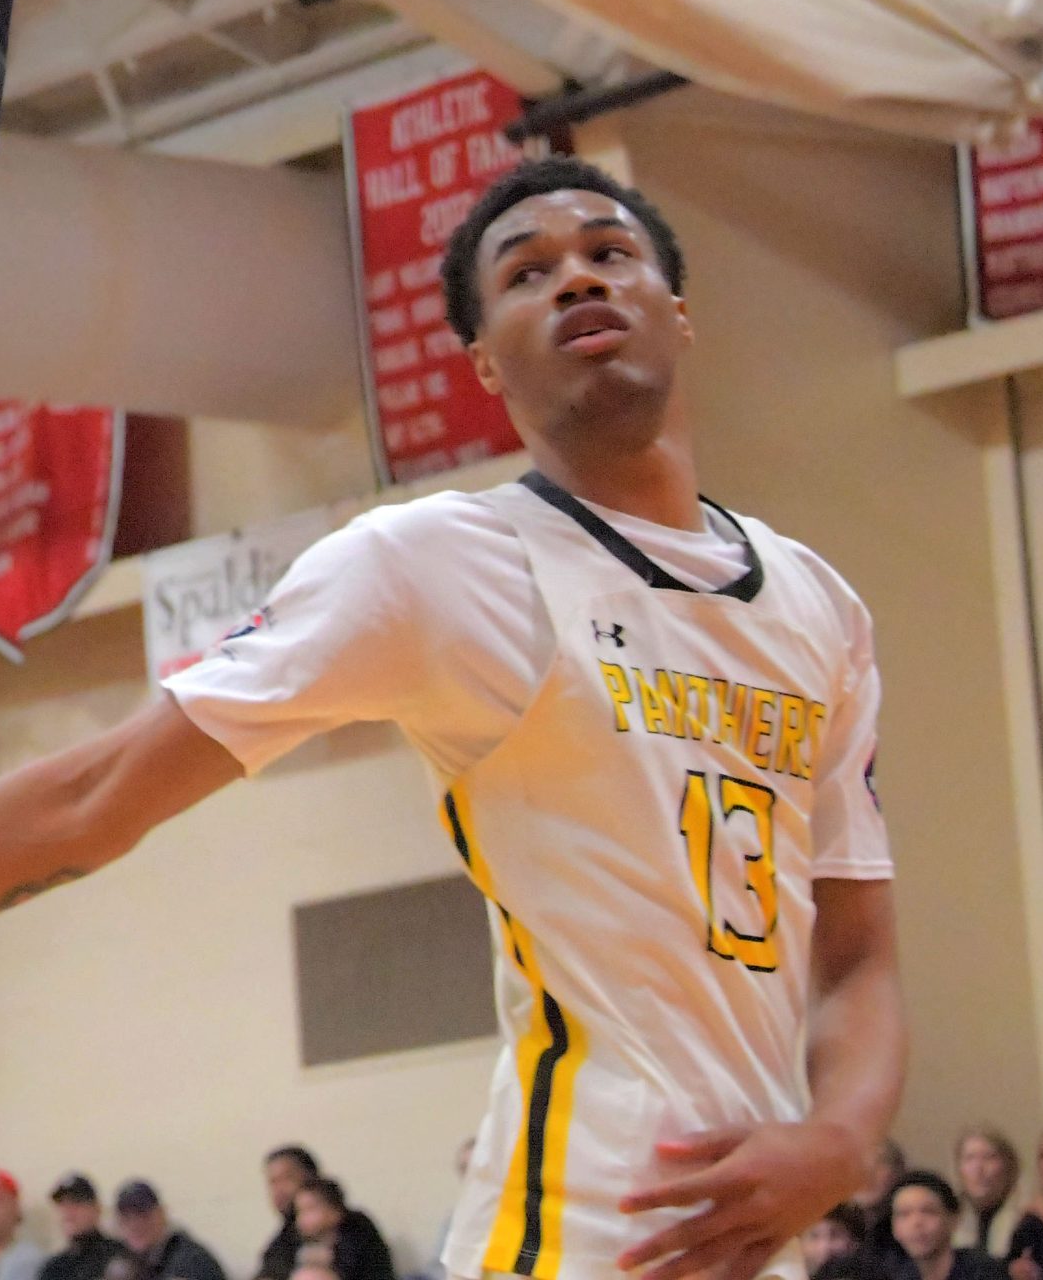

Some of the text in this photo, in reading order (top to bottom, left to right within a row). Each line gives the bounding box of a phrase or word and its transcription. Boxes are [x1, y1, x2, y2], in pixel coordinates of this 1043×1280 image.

[363, 154, 424, 211] HALL
[429, 140, 460, 190] OF
[598, 658, 826, 780] PANTHERS
[679, 769, 778, 973] 13
